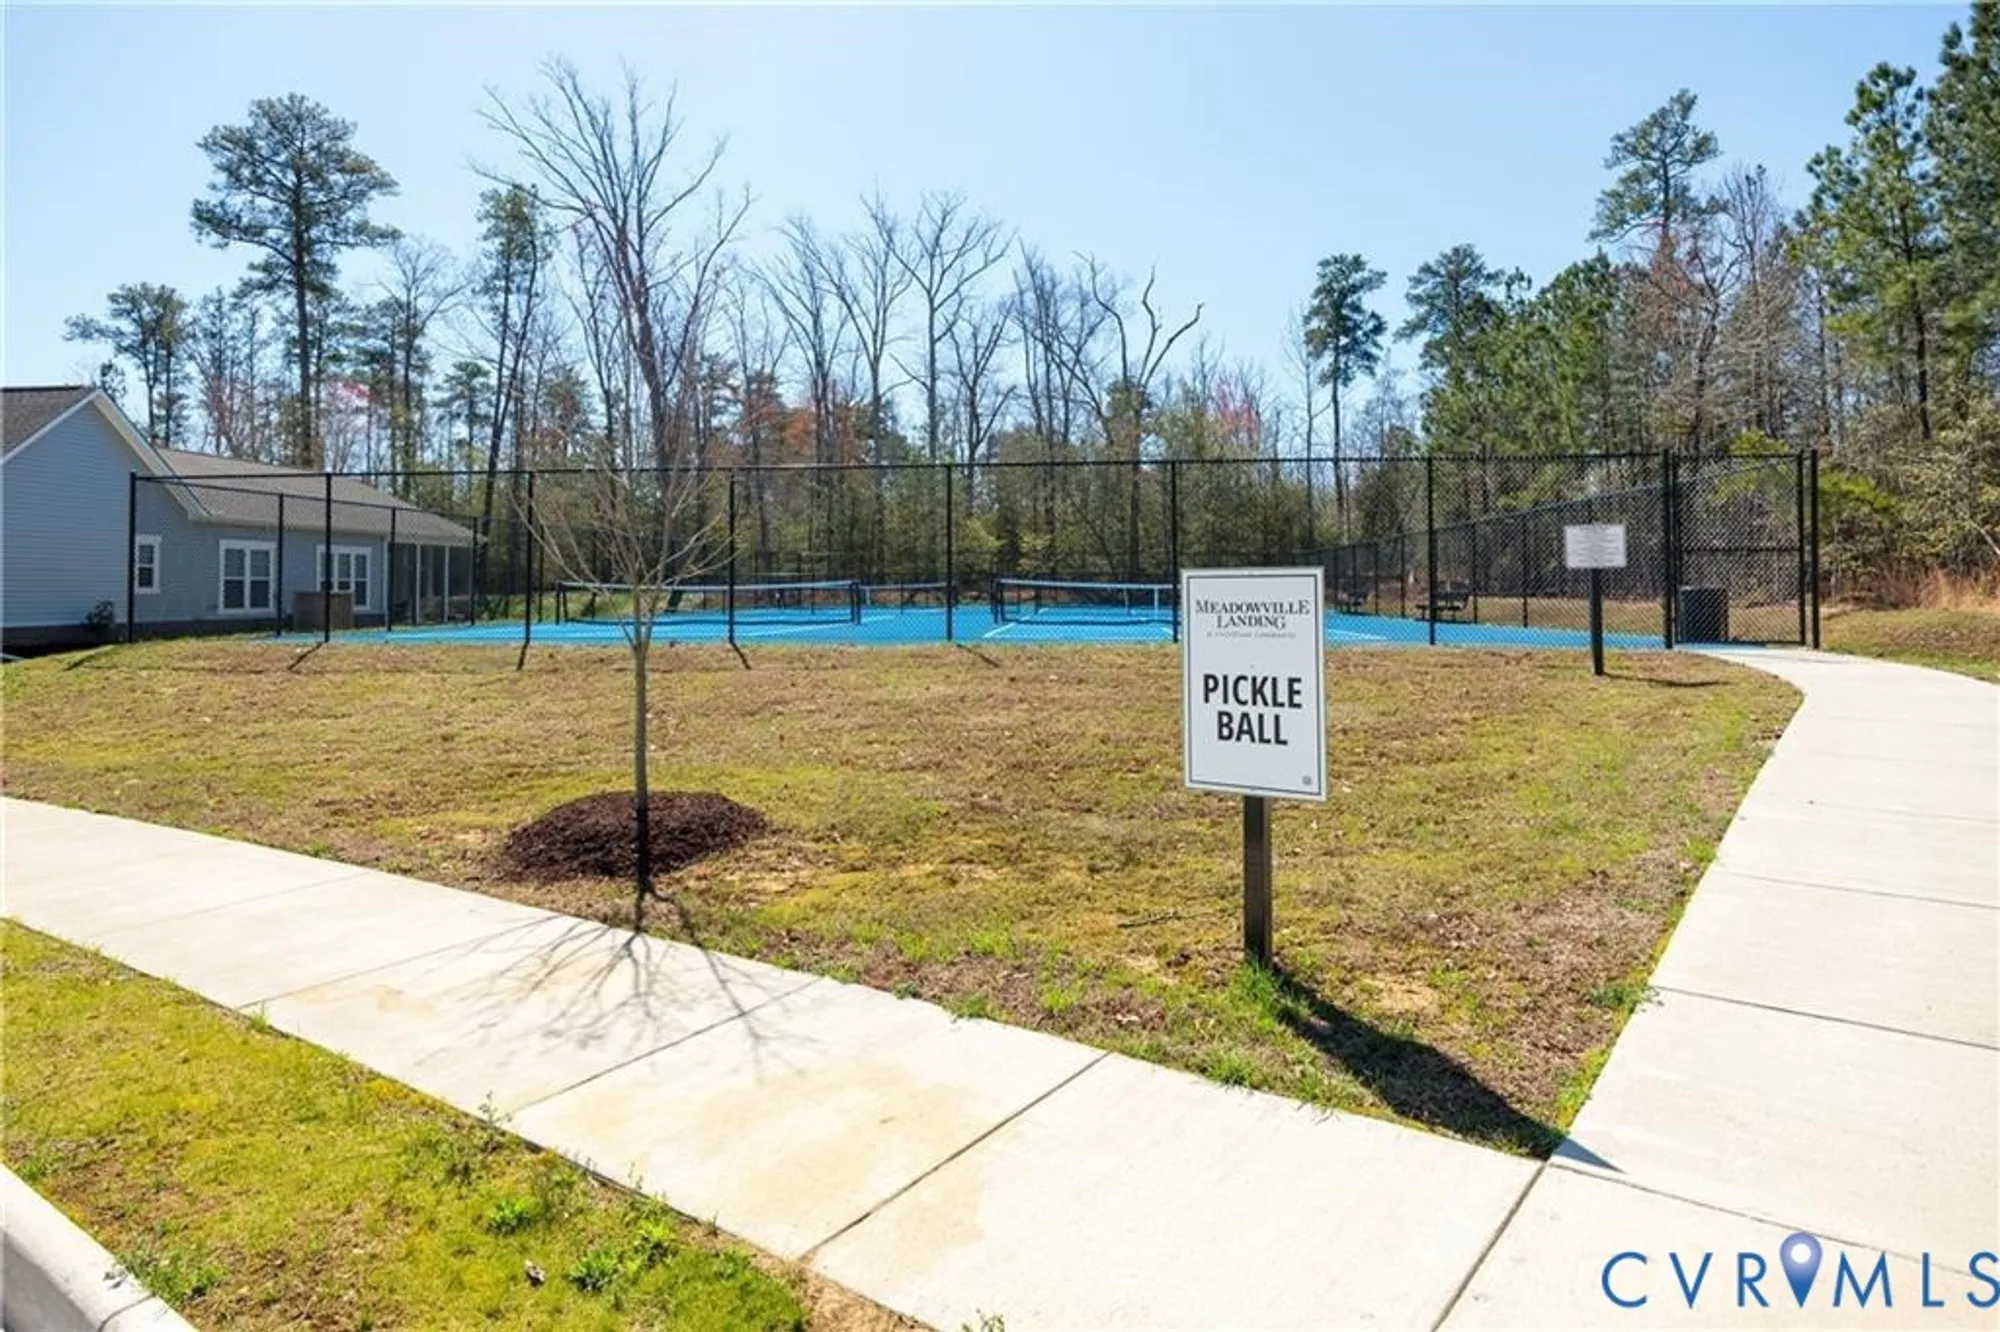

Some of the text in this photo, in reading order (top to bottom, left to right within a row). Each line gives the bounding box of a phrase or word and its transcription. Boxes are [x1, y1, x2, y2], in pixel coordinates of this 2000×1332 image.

[1216, 615, 1286, 630] LANDING
[1203, 673, 1302, 709] PICKLE
[1217, 710, 1288, 746] BALL
